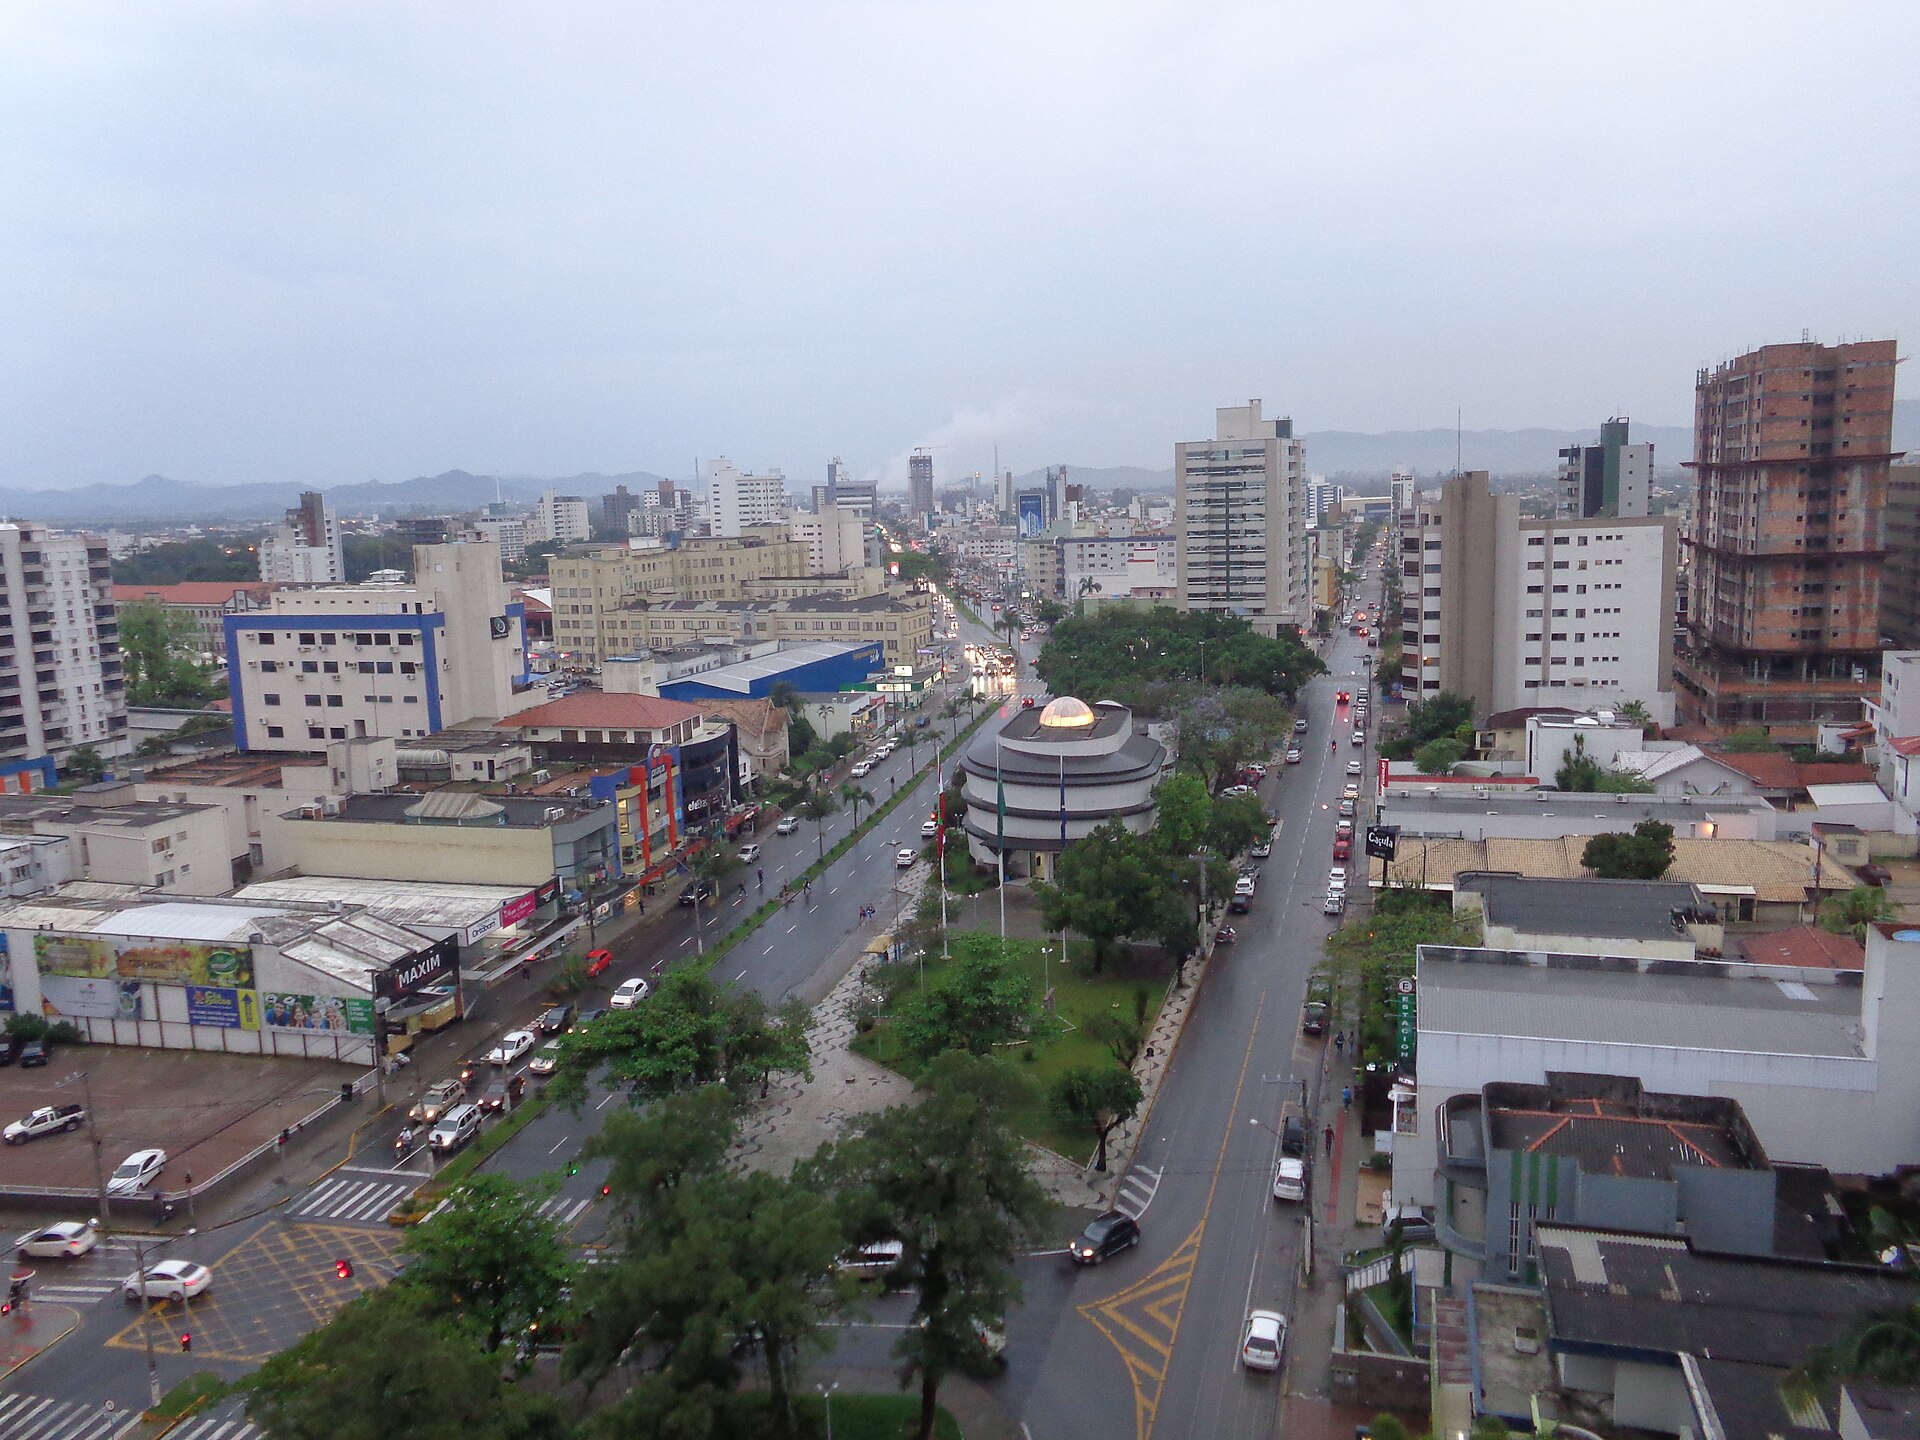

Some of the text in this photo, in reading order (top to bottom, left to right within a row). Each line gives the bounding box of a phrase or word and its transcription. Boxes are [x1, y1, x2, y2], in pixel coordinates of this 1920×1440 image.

[1368, 832, 1394, 848] Caçula
[399, 954, 440, 988] MAXIM
[1402, 982, 1410, 991] E
